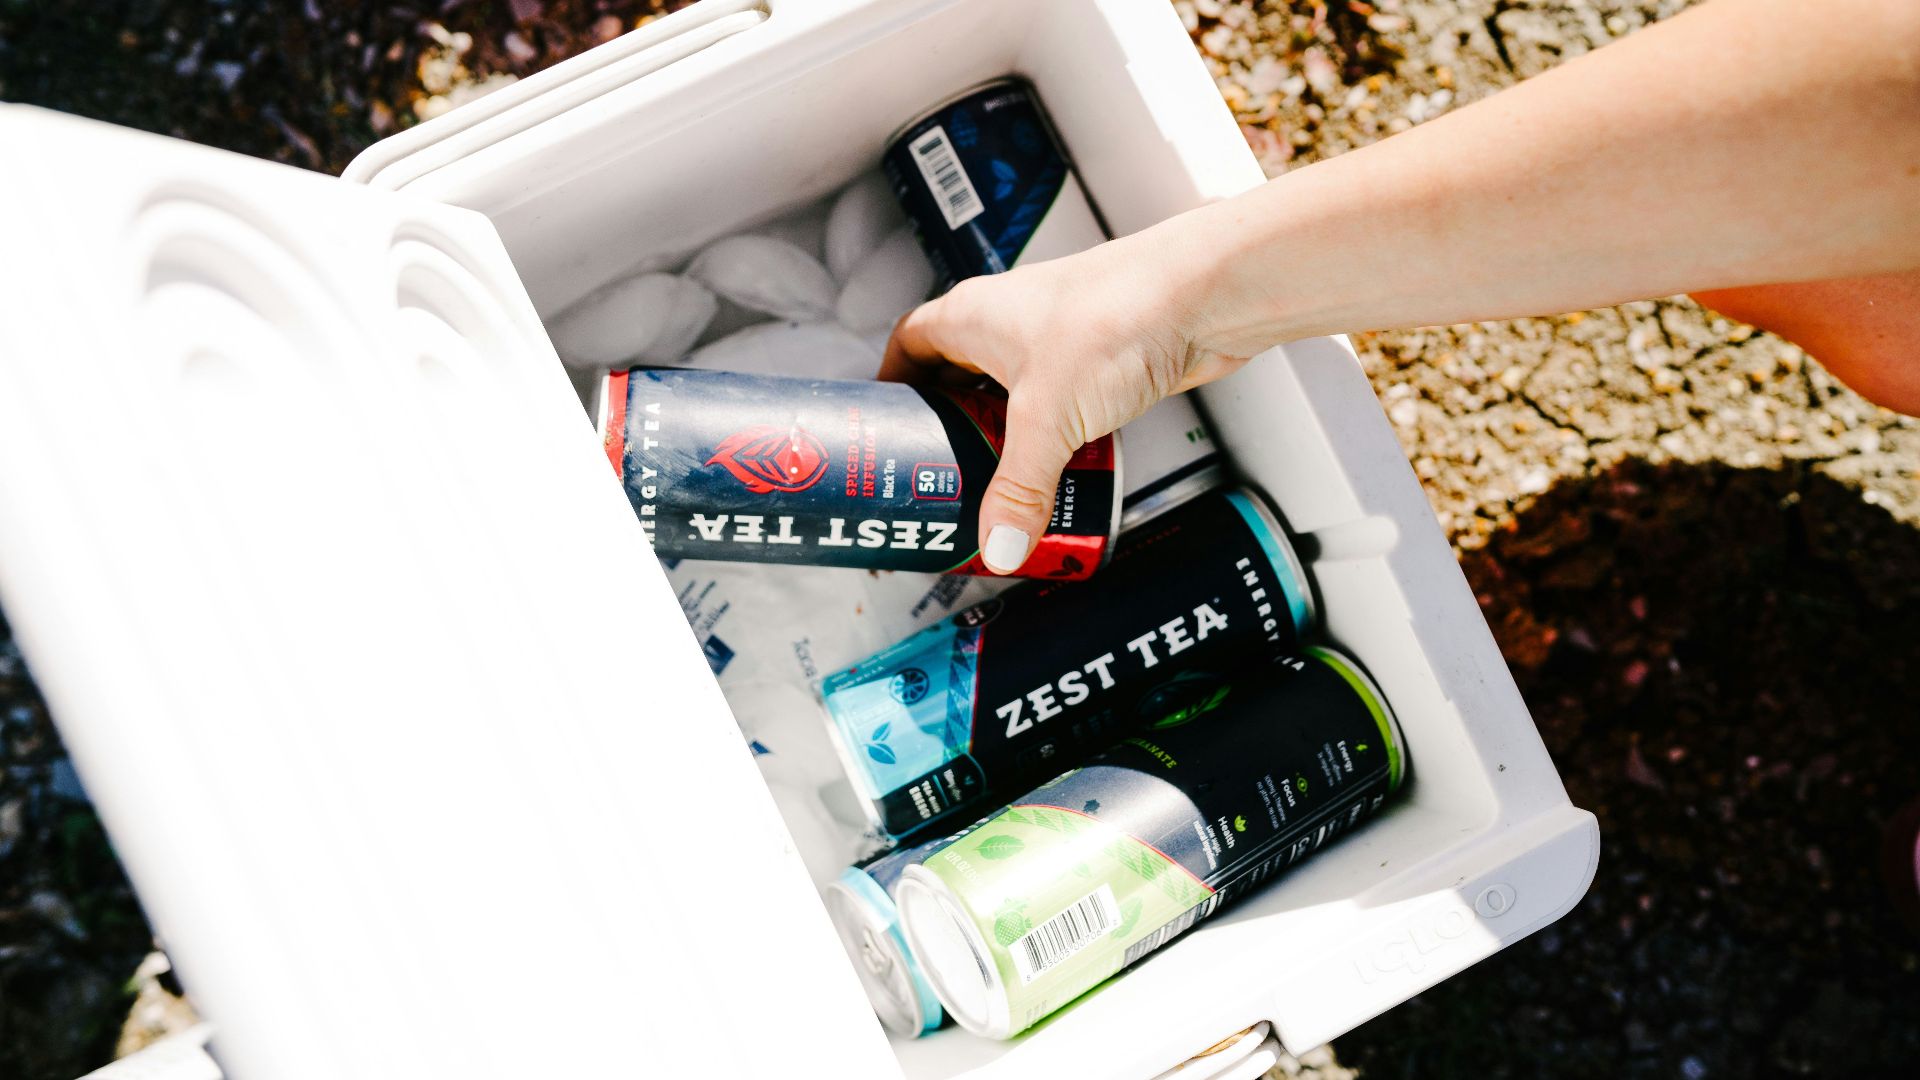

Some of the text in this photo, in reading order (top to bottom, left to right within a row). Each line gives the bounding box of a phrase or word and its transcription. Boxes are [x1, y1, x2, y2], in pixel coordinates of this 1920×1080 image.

[640, 402, 660, 550] NERGY TEA
[846, 444, 859, 497] SPICED
[863, 426, 876, 497] INFUSION
[883, 459, 896, 498] Black Tea
[918, 470, 936, 493] 50
[1062, 478, 1075, 527] ENERGY
[689, 513, 958, 551] ZEST TEA
[1236, 557, 1279, 642] ENERGY
[996, 652, 1116, 739] ZEST
[1127, 603, 1229, 669] TEA
[1337, 740, 1353, 773] Energy
[1281, 778, 1296, 807] Focus
[1205, 824, 1216, 838] Low
[1218, 815, 1236, 849] Health
